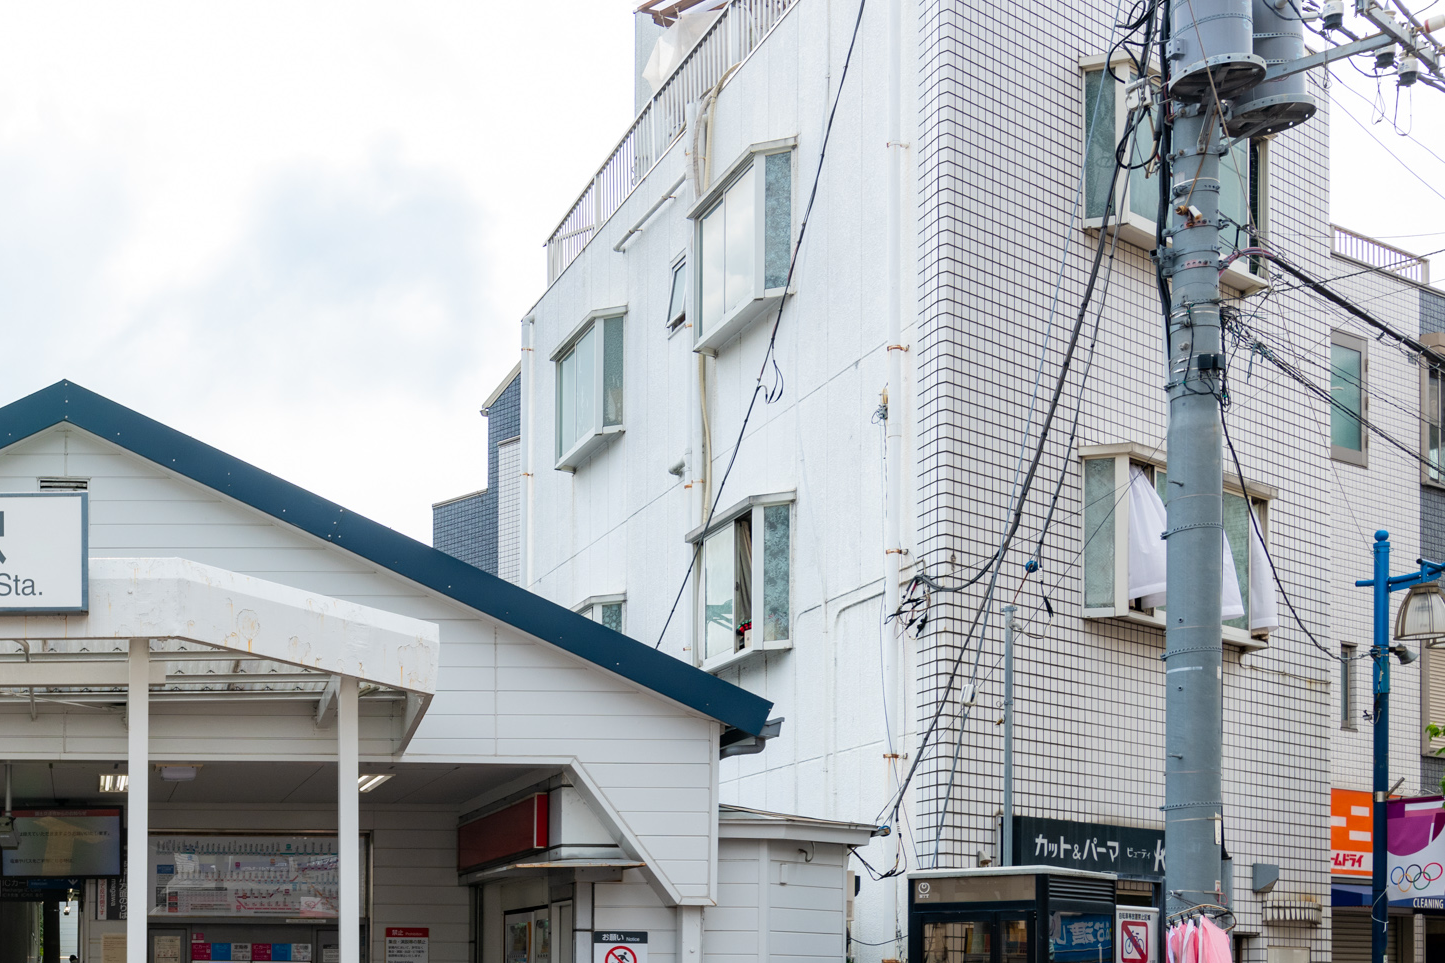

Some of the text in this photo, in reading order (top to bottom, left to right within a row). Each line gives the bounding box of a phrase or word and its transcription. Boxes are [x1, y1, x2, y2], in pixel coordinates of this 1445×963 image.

[1035, 833, 1119, 863] カット&パーマ
[1127, 847, 1151, 859] ビューティ
[1413, 897, 1444, 909] CLEANING
[602, 933, 625, 941] お願い
